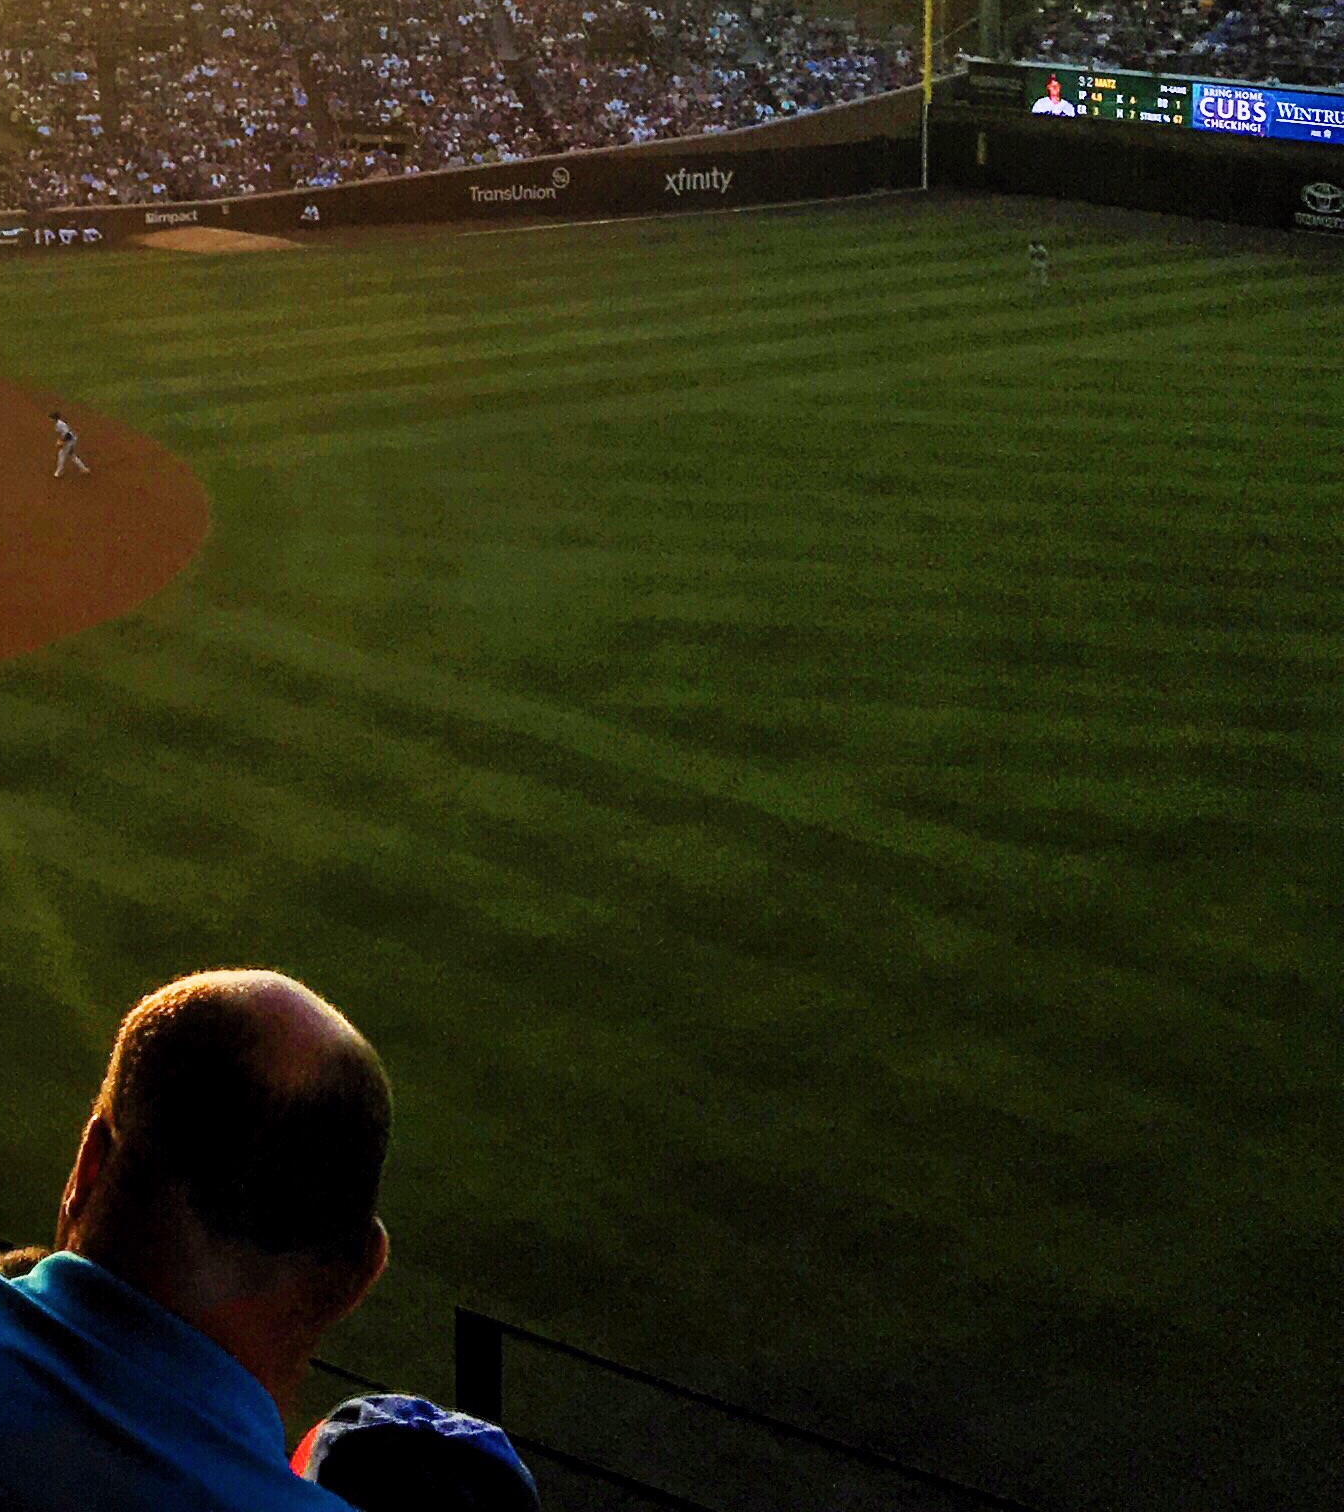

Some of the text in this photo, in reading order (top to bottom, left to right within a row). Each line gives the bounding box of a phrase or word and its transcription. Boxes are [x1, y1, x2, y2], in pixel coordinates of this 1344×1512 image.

[1204, 87, 1264, 101] BRING HOME
[1199, 96, 1267, 123] CUBS
[1204, 118, 1261, 133] CHECKING!
[664, 167, 734, 196] xfinity
[469, 184, 556, 202] TransUnion
